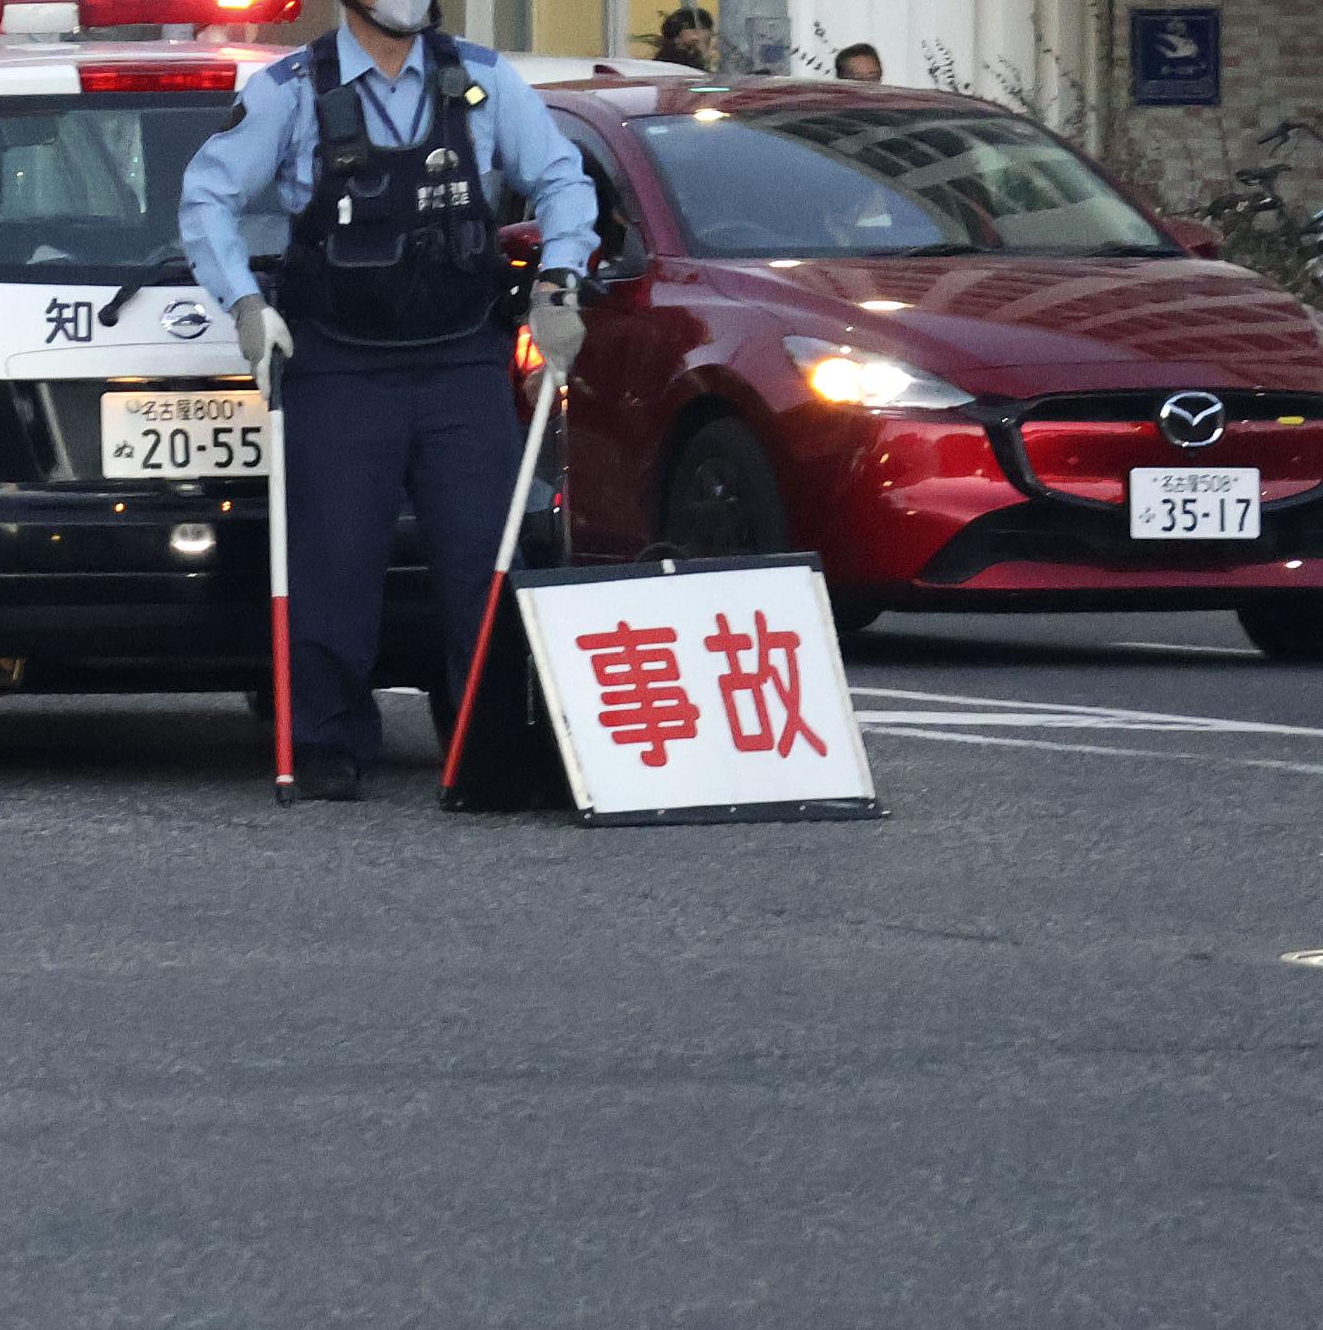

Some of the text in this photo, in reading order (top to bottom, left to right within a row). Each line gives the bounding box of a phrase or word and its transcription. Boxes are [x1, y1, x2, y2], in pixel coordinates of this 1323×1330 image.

[141, 398, 235, 421] 名古屋800
[141, 426, 263, 470] 20-55
[1161, 498, 1252, 533] 35-17
[574, 608, 829, 768] 事故
